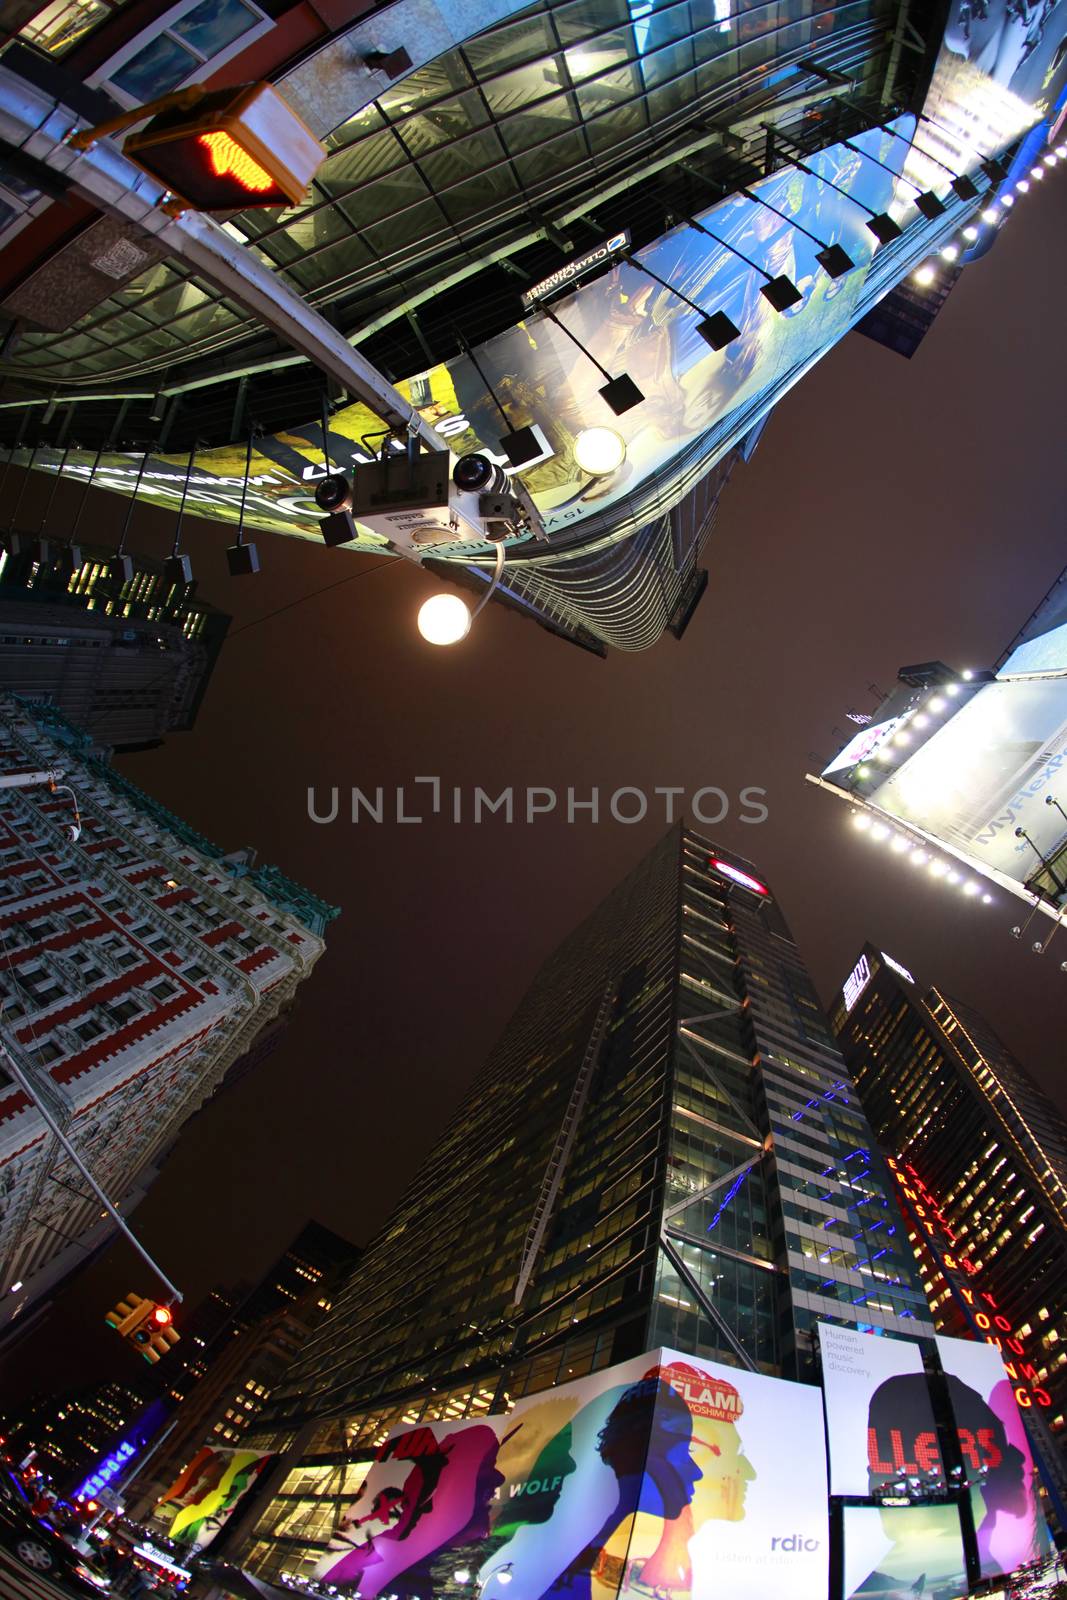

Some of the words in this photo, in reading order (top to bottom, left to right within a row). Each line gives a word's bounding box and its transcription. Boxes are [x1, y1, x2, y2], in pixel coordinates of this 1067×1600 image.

[564, 508, 585, 520] 15
[976, 746, 1067, 845] MyFlexP
[888, 1156, 934, 1236] ERNST
[943, 1254, 958, 1270] &
[961, 1288, 1031, 1408] YOUNG
[825, 1329, 857, 1342] Human
[826, 1341, 865, 1355] powered
[828, 1352, 854, 1363] music
[829, 1361, 872, 1379] discovery
[687, 1403, 725, 1418] YOSHIMI
[510, 1476, 562, 1498] WOLF
[771, 1534, 820, 1552] rdio
